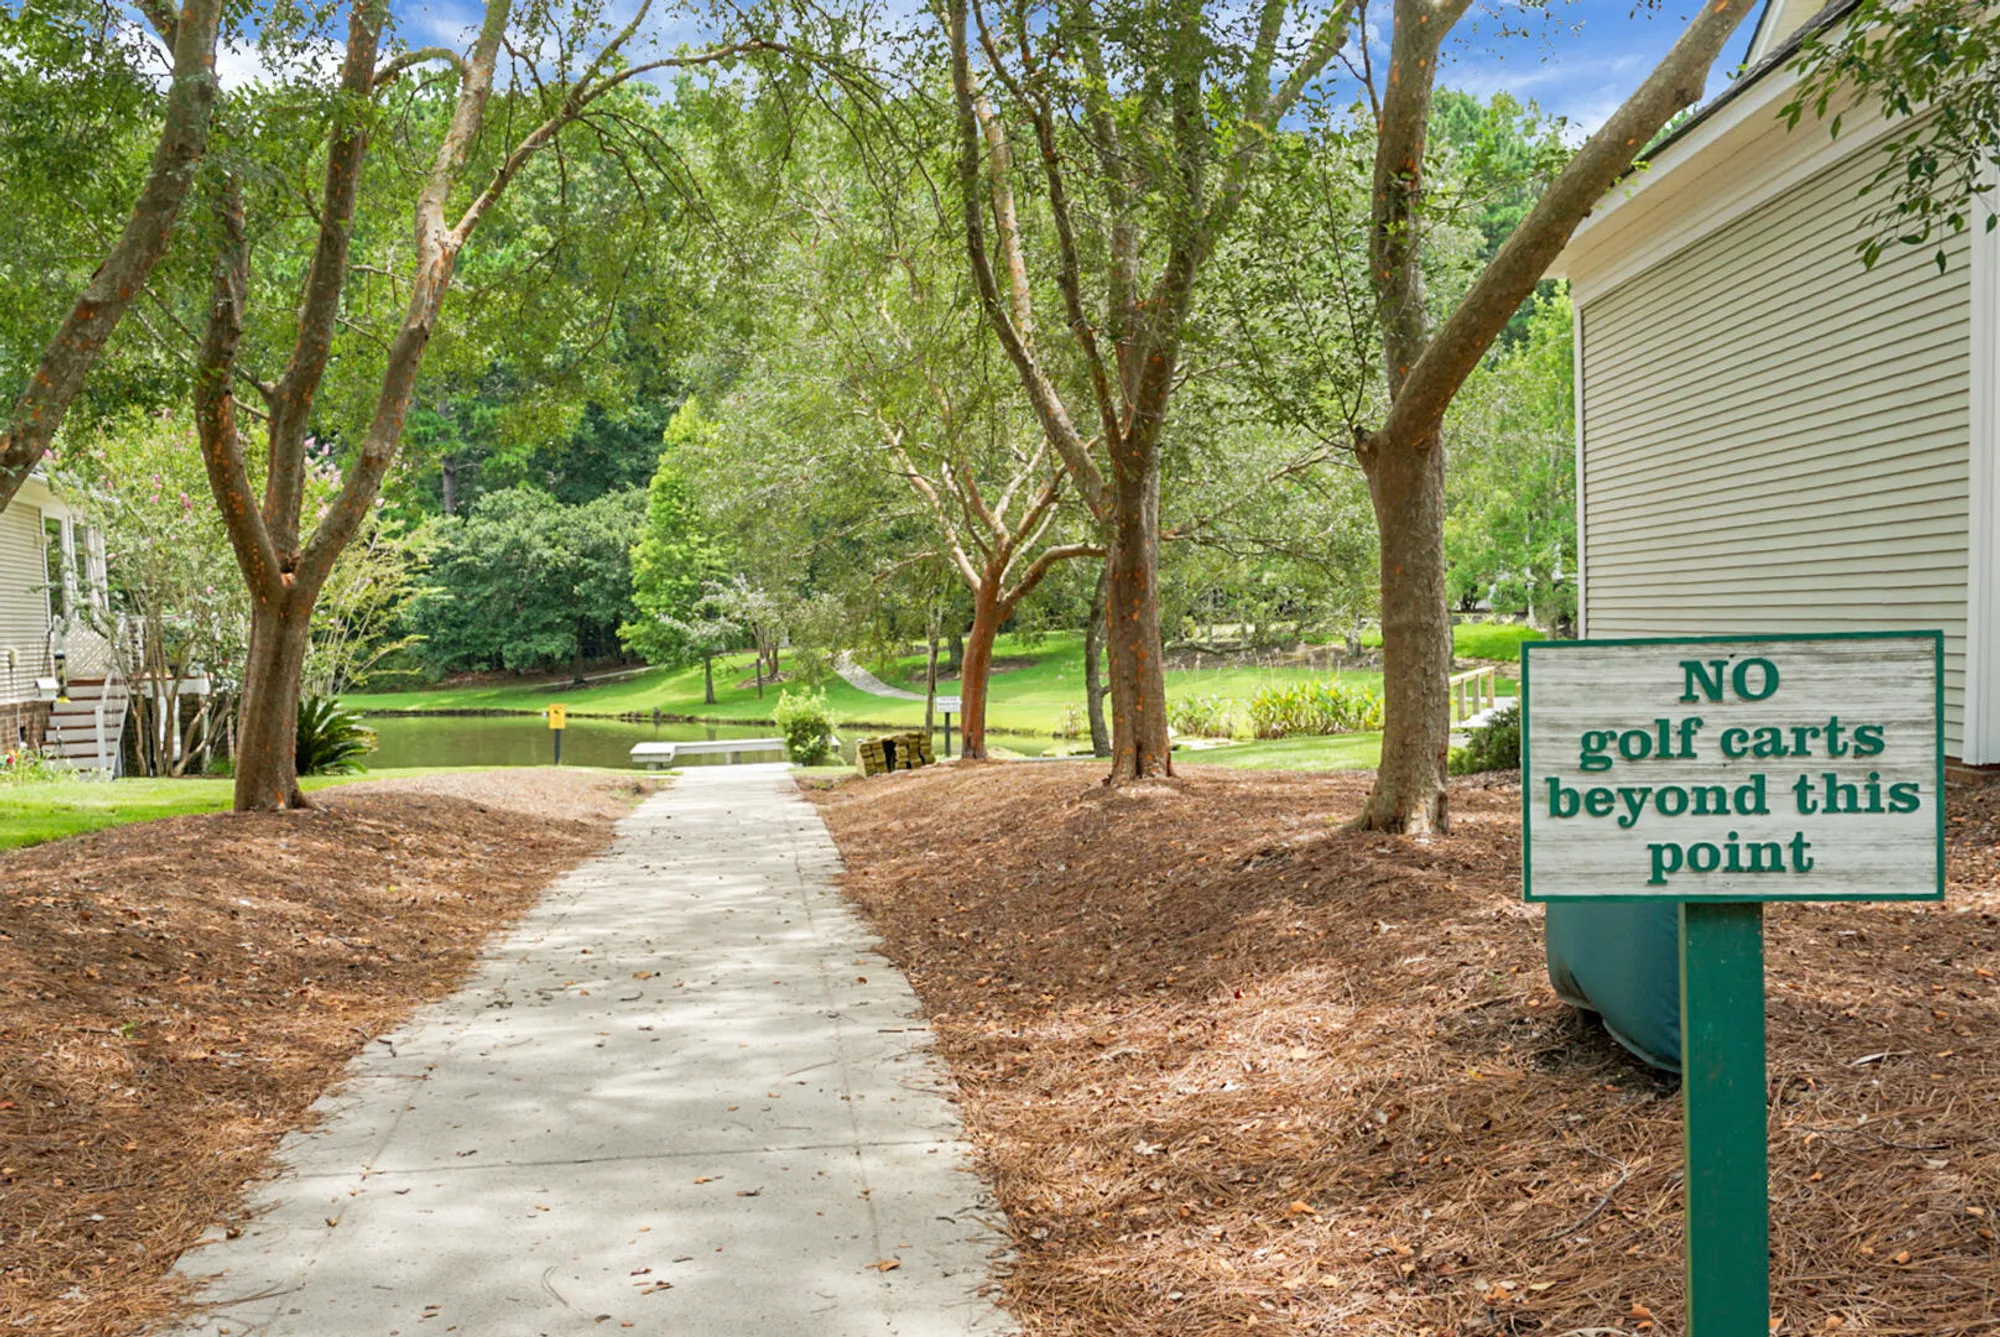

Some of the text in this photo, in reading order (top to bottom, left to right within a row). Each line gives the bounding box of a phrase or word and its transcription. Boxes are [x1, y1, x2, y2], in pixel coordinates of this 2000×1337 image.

[1679, 657, 1780, 703] NO
[1578, 715, 1886, 773] golf carts
[1544, 771, 1921, 829] beyond this
[1646, 831, 1815, 886] point
